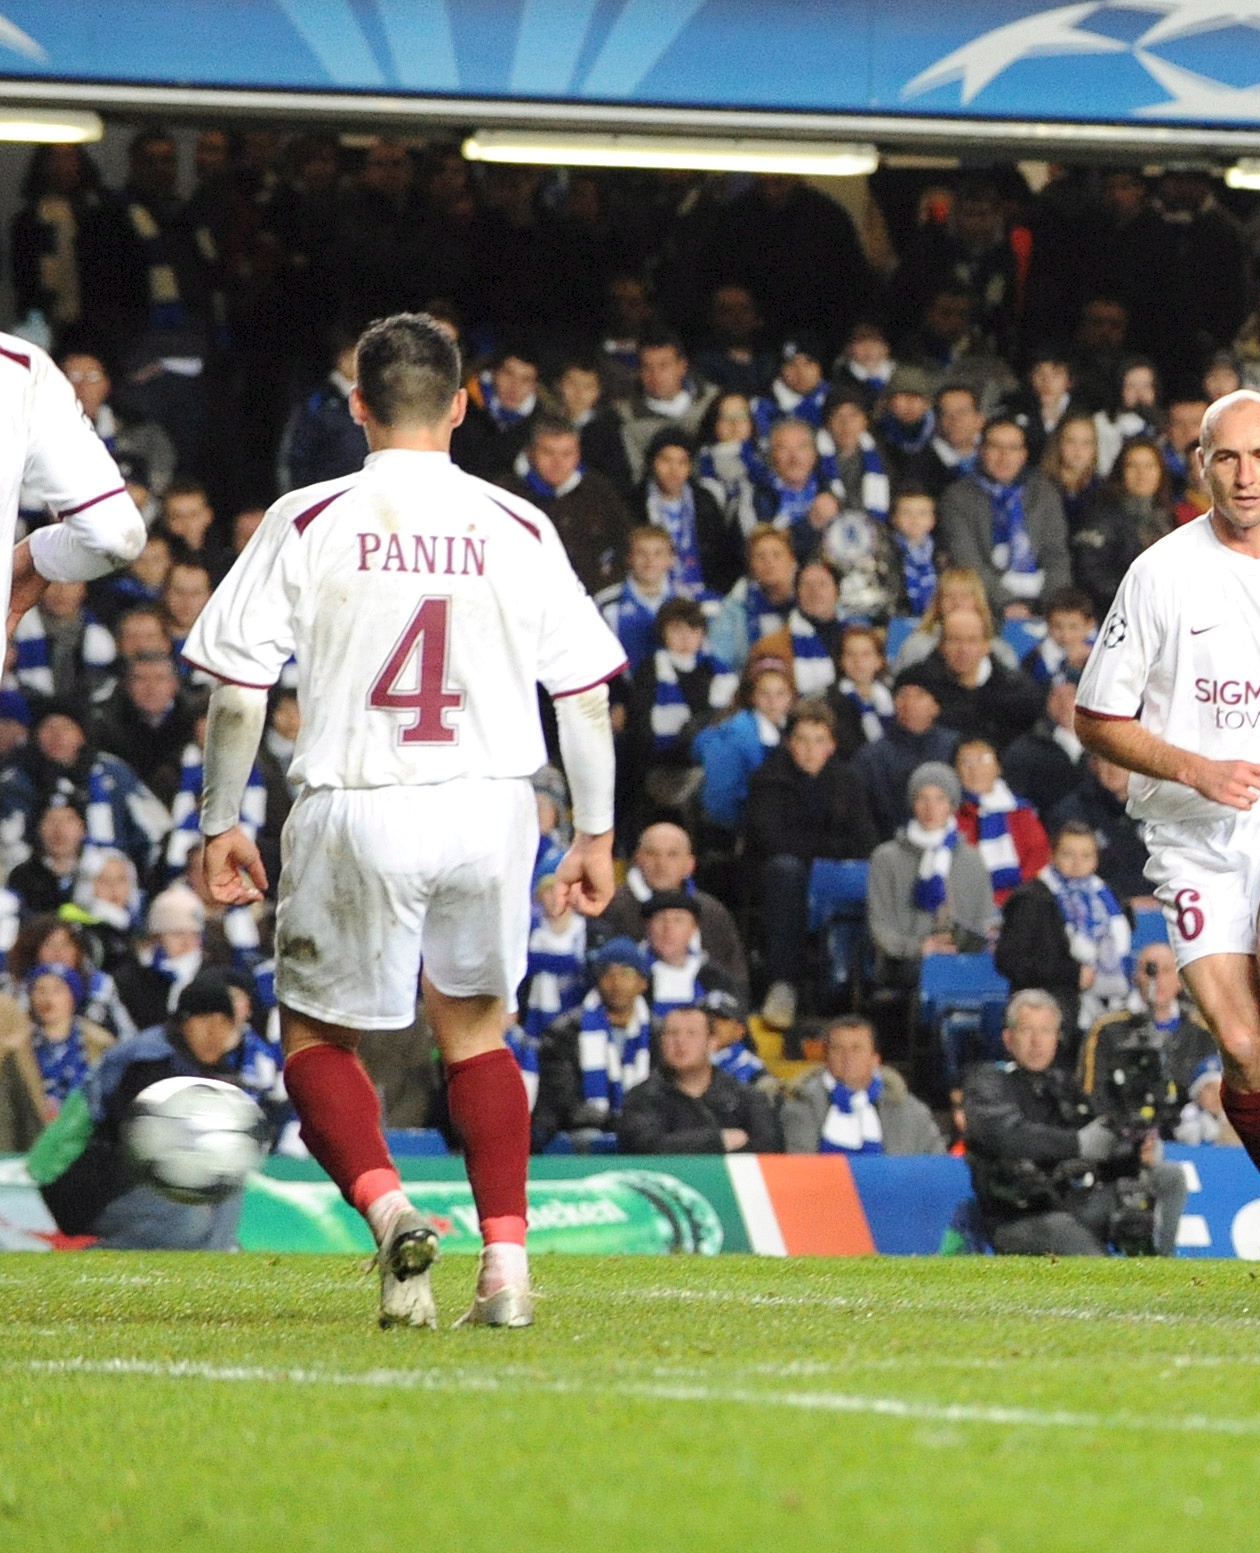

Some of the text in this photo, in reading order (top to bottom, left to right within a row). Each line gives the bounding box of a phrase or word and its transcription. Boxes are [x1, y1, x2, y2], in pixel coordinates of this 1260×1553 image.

[356, 532, 487, 577] PANIN
[366, 595, 466, 746] 4
[1174, 888, 1204, 942] 6
